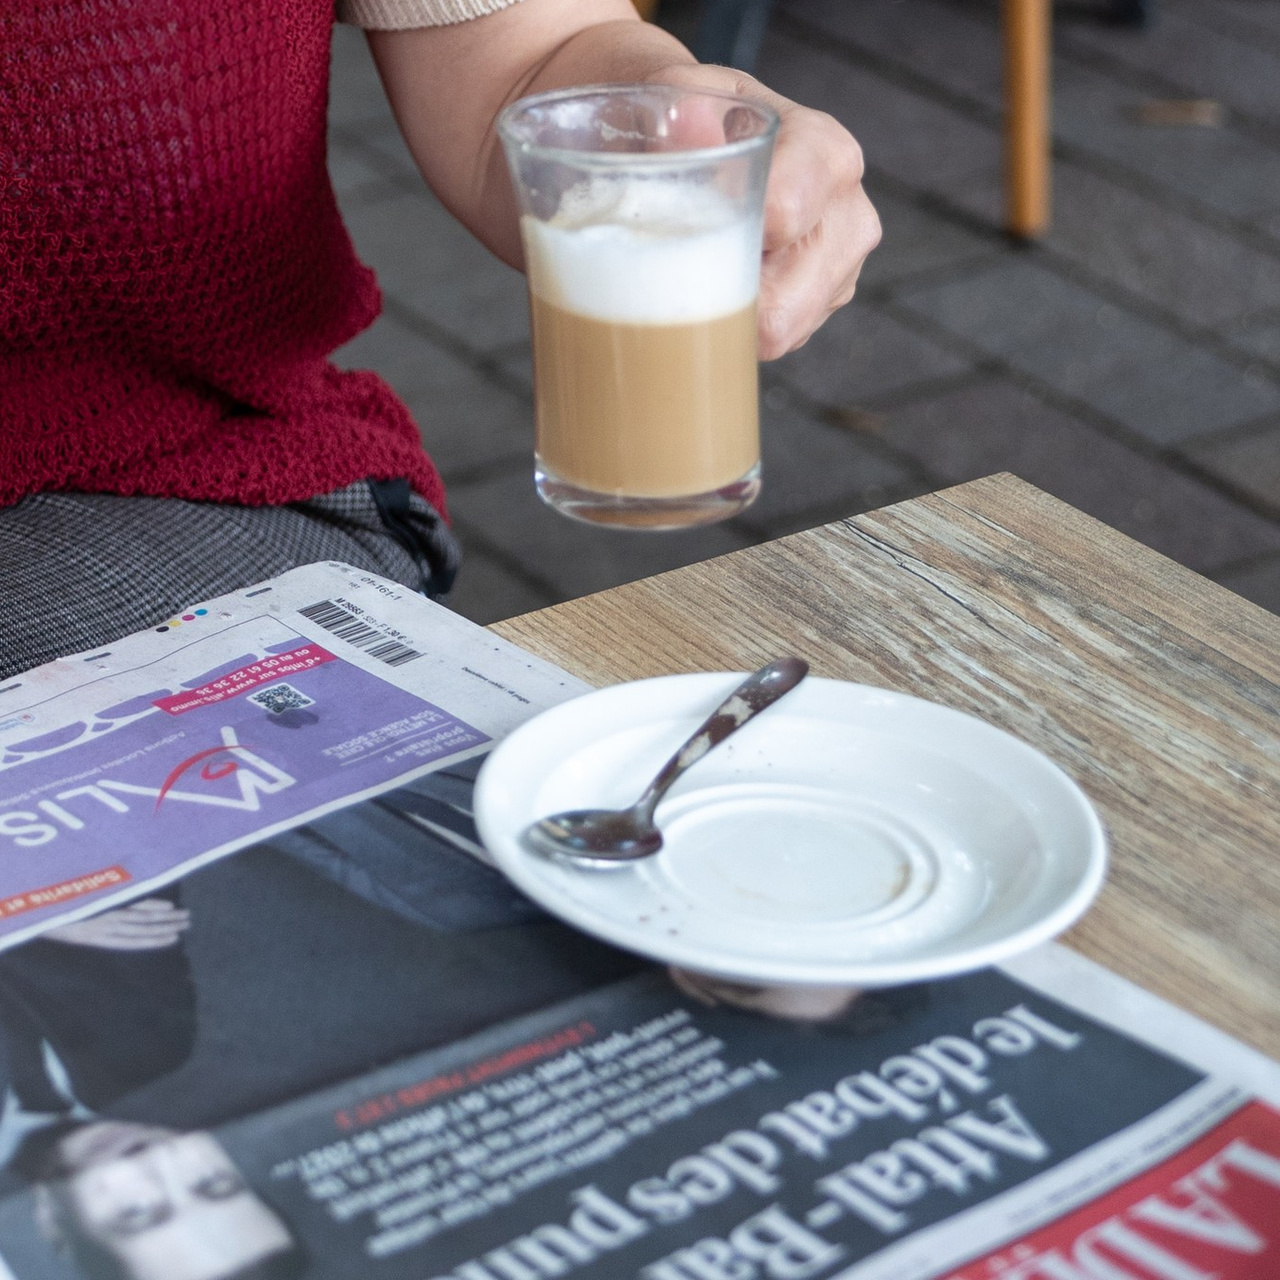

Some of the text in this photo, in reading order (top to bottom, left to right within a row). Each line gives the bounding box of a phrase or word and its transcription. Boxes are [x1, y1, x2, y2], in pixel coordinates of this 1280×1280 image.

[168, 653, 326, 715] +d'infos sur www.alis.immo
[192, 647, 311, 696] ou au 05 61 22 36 36
[966, 1002, 1090, 1058] le
[752, 1036, 996, 1163] débat
[619, 1129, 772, 1221] des
